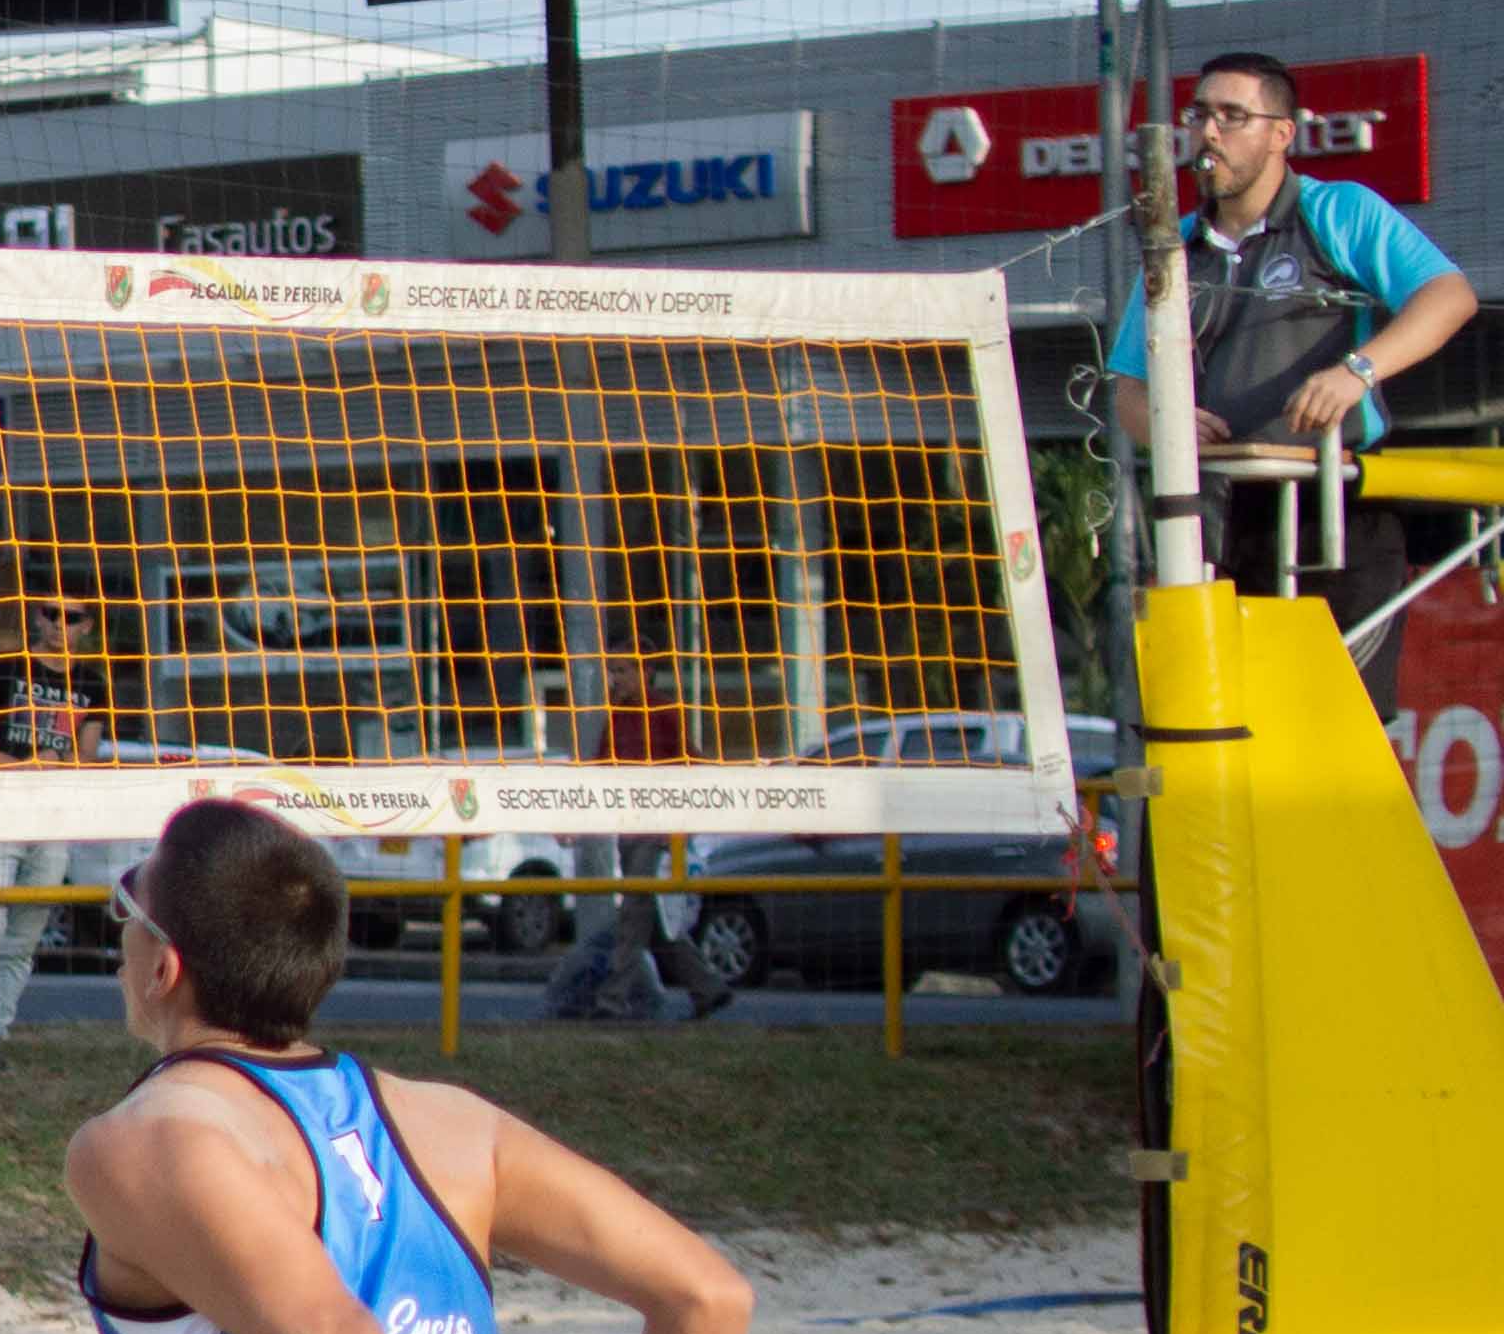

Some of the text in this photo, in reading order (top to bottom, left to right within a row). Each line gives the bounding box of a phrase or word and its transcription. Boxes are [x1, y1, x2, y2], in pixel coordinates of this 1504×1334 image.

[190, 279, 344, 305] ALCALDÍA DE PEREIRA
[406, 284, 734, 316] SECRETARÍA DE RECREACIÓN Y DEPORTE
[16, 680, 91, 707] TOMMY
[8, 728, 71, 750] HILFIG
[275, 786, 432, 812] ALCALDÍA DE PEREIRA
[497, 784, 827, 812] SECRETARÍA DE RECREACIÓN Y DEPORTE
